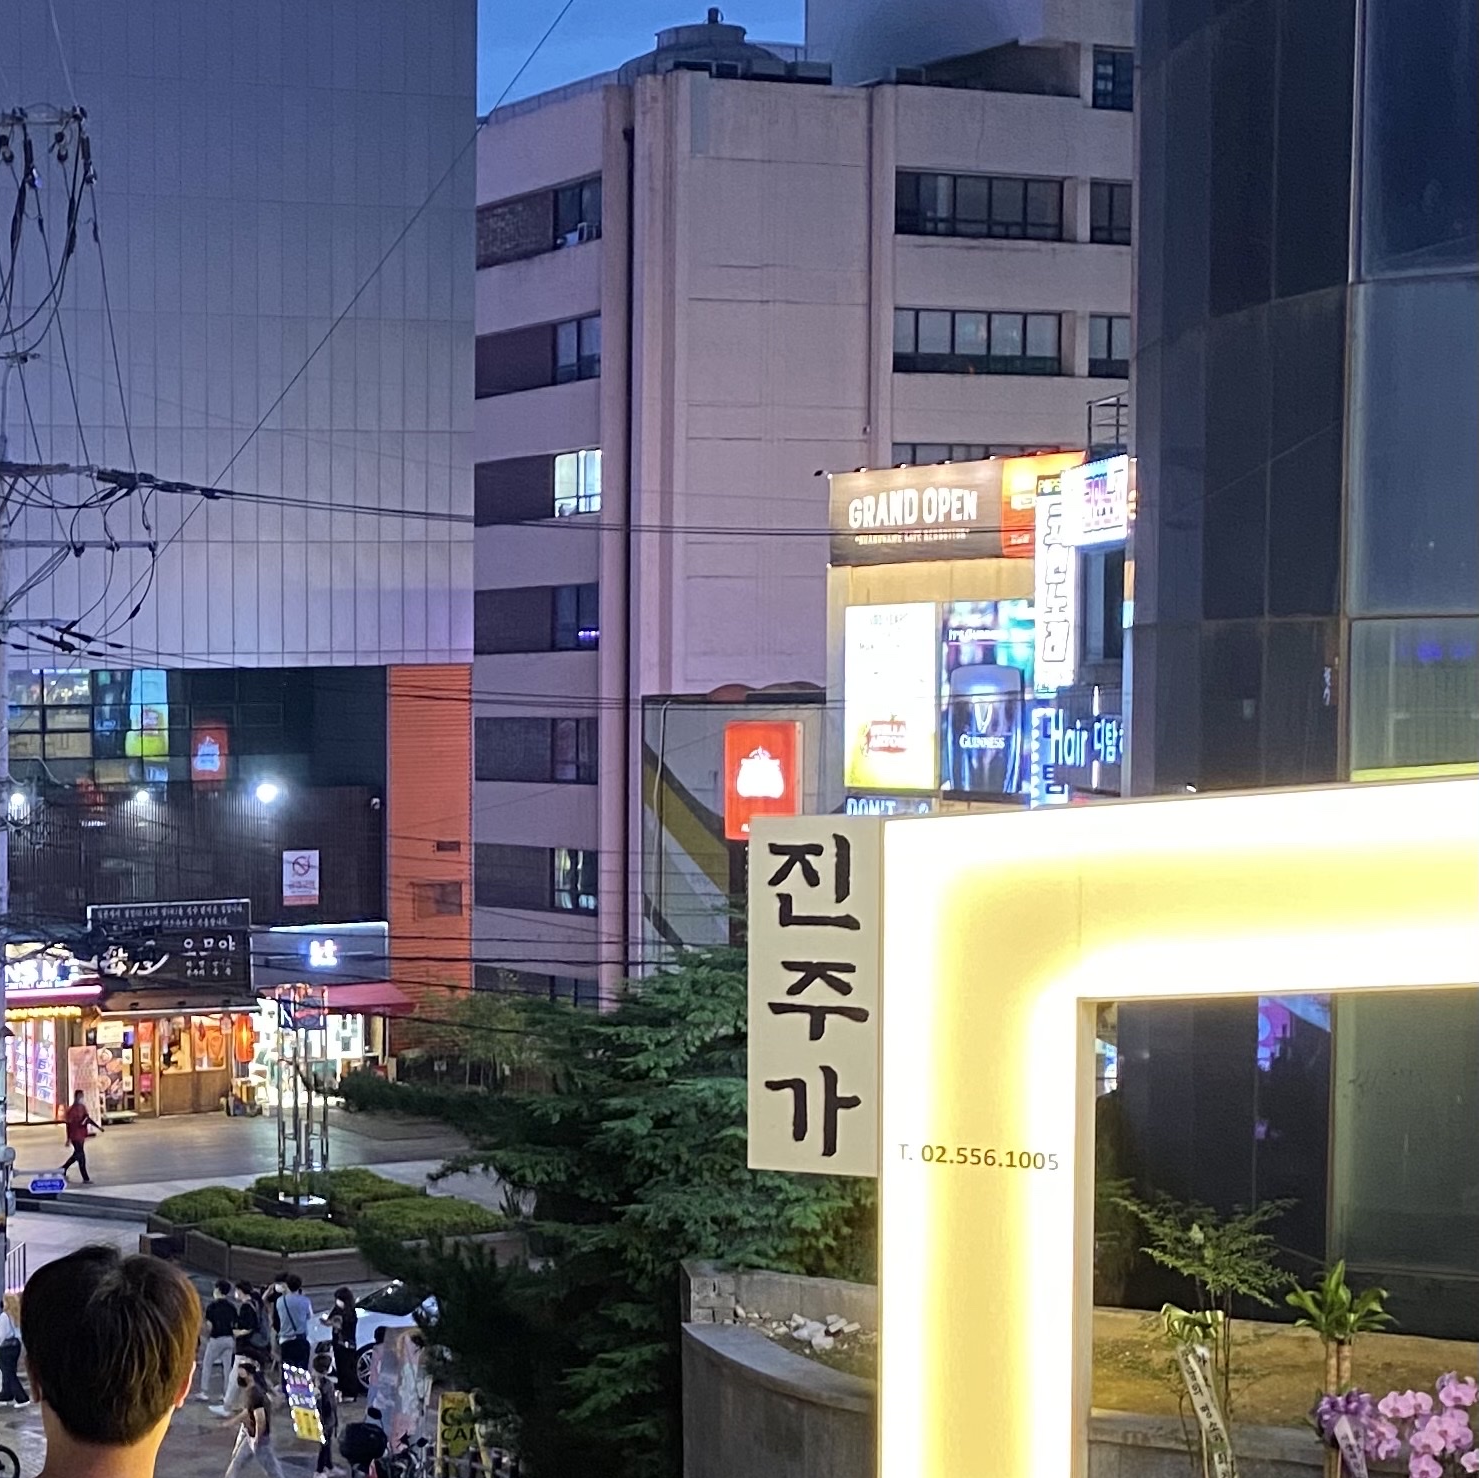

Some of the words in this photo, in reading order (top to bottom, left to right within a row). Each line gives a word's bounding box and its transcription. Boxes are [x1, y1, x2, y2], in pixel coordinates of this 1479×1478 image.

[848, 488, 919, 529] GRAND
[922, 486, 978, 524] OPEN
[1050, 707, 1089, 767] Hair
[764, 832, 870, 1157] 진주가
[898, 1143, 913, 1160] T.
[921, 1144, 1059, 1170] 02.556.1005
